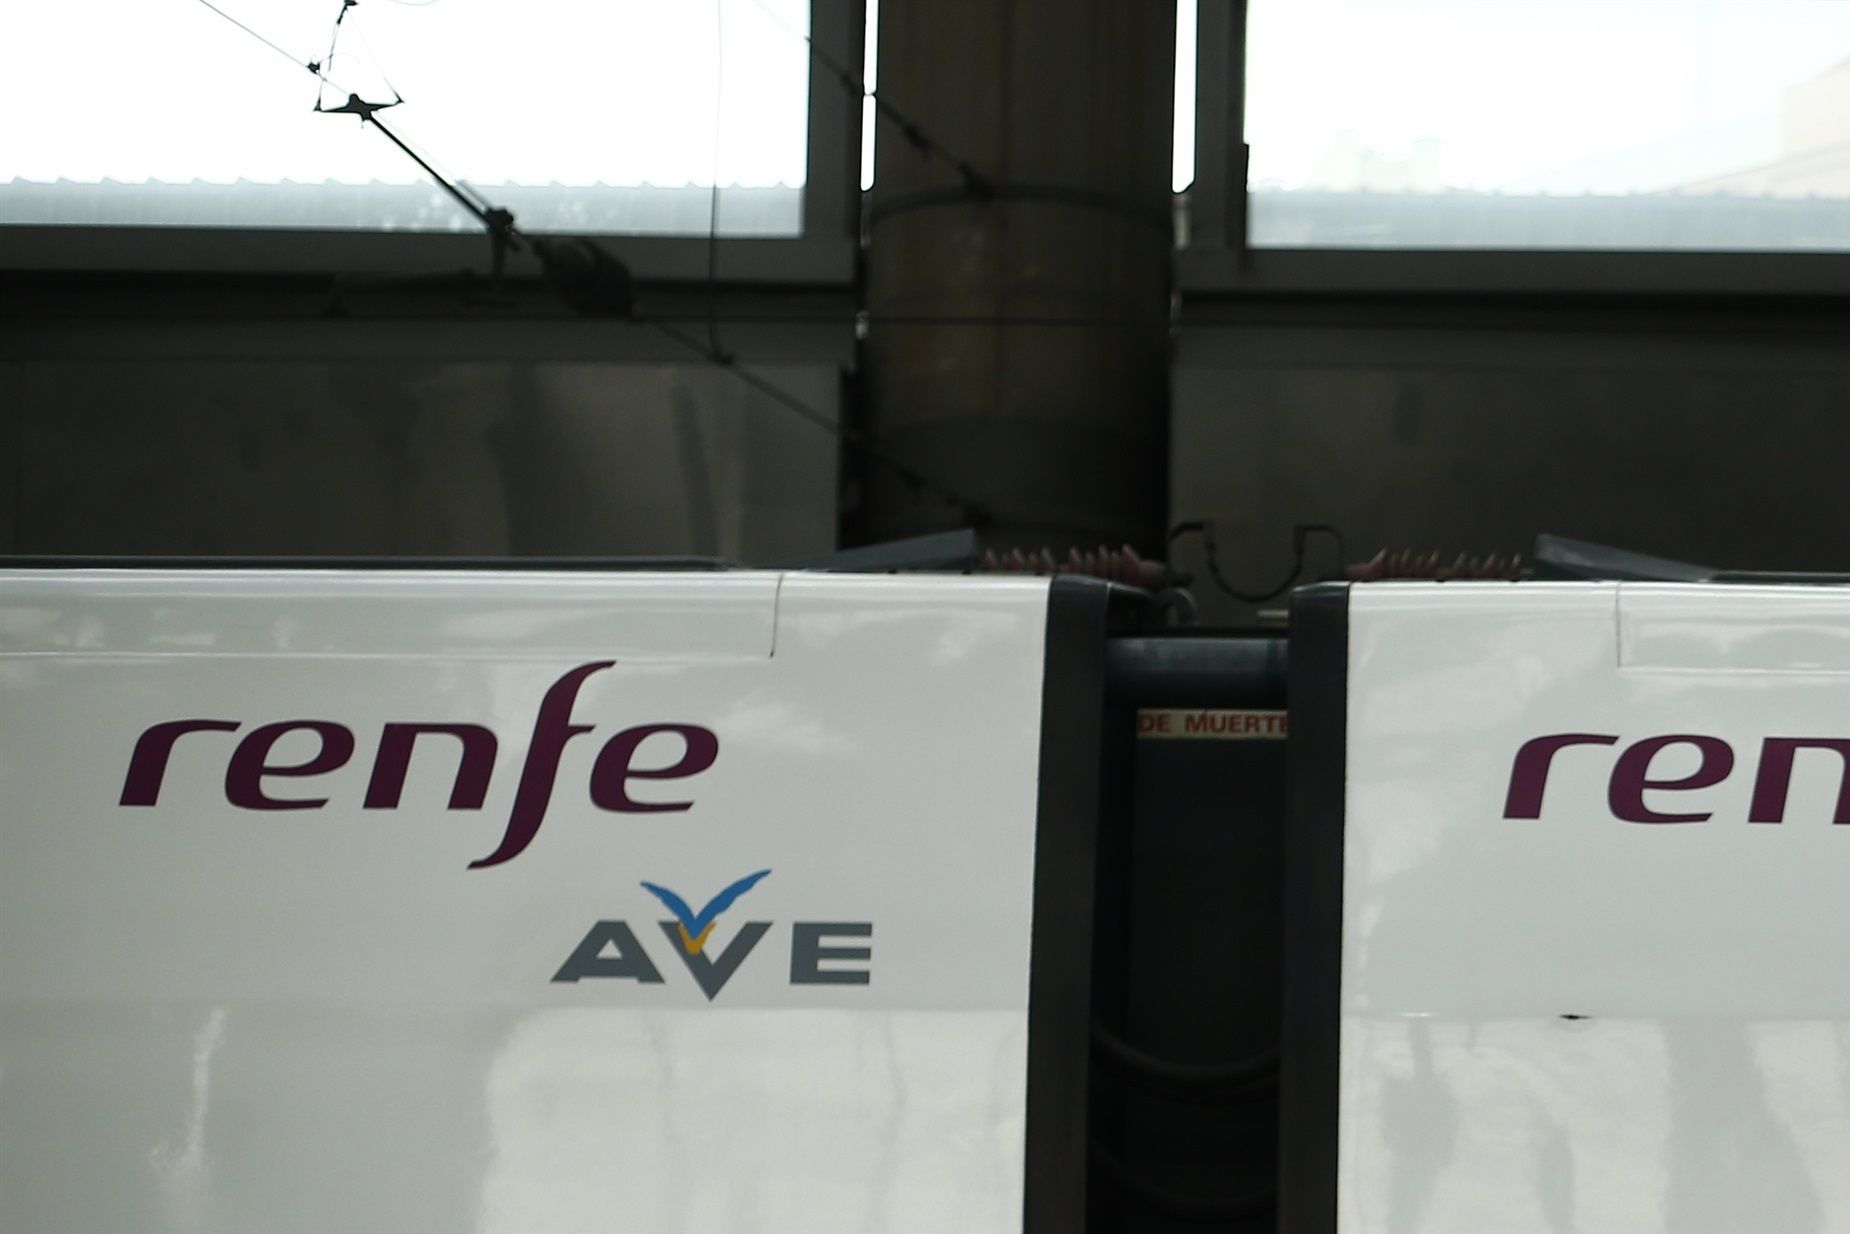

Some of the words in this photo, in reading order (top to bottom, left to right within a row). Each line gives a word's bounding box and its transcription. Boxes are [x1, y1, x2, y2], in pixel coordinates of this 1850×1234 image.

[1138, 713, 1171, 733] DE
[118, 660, 719, 870] renfe
[549, 919, 873, 1001] AVE
